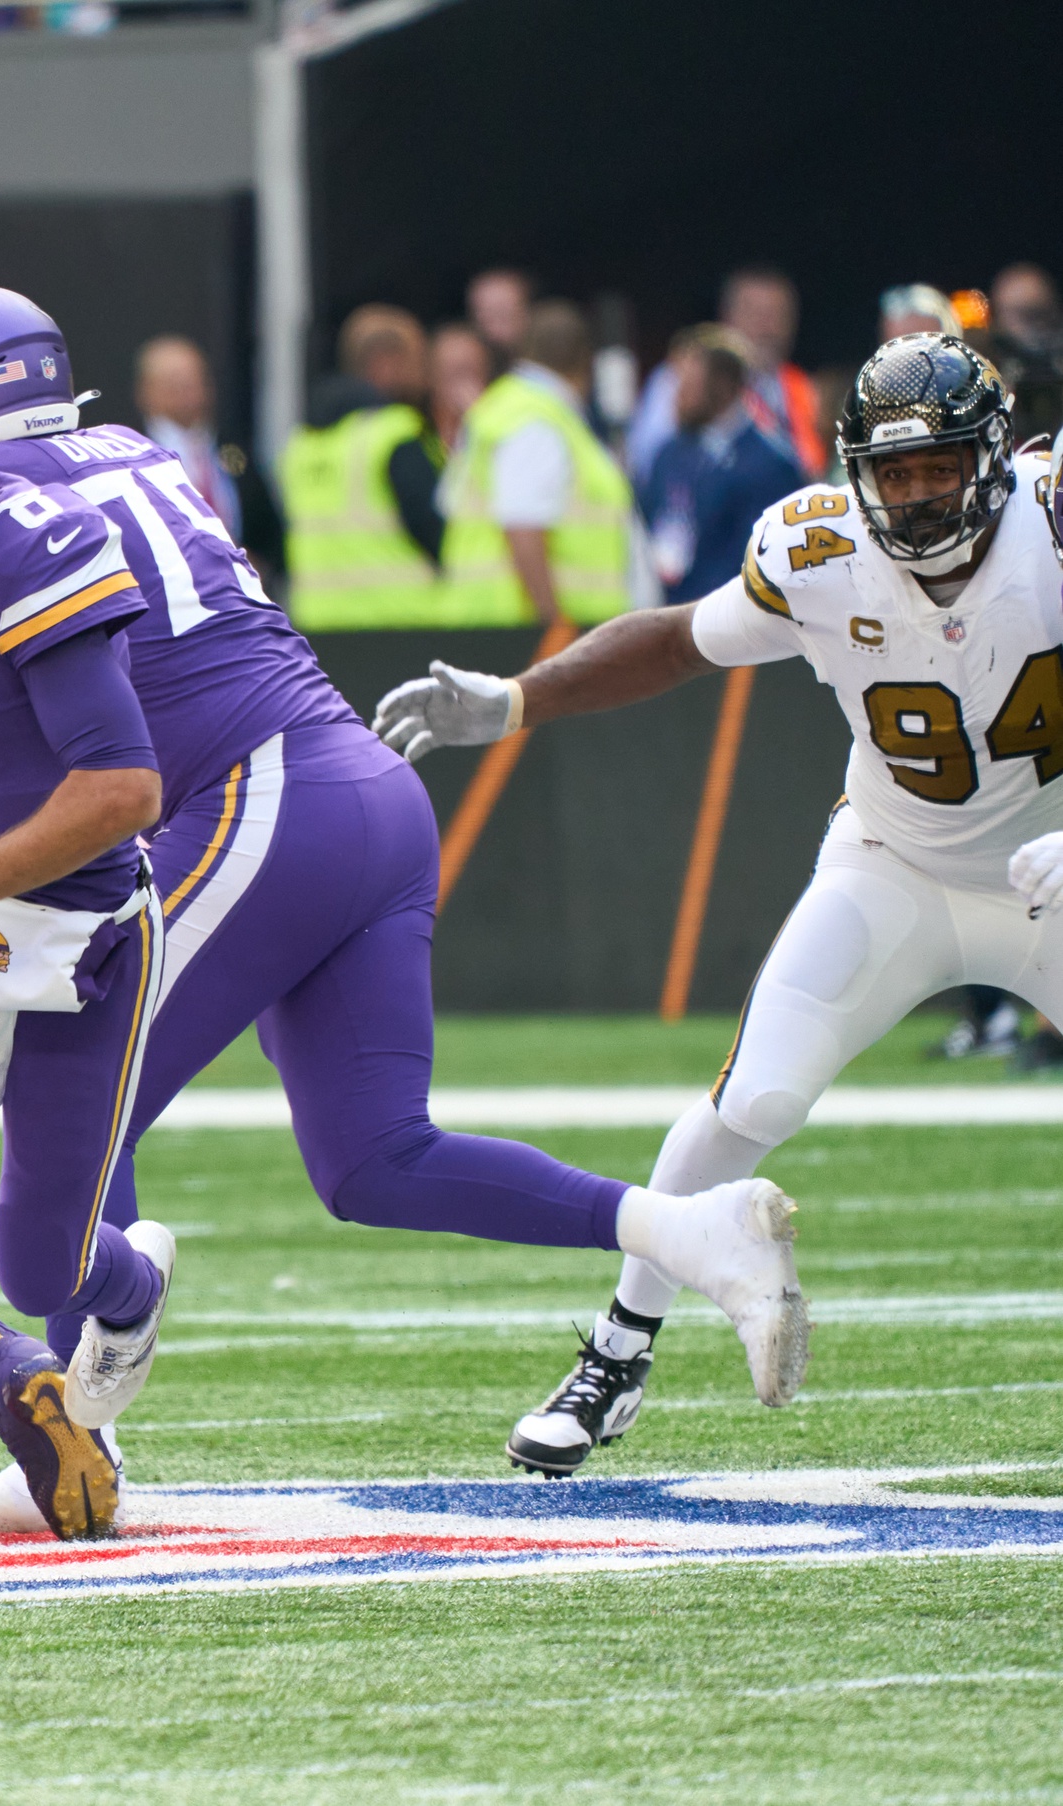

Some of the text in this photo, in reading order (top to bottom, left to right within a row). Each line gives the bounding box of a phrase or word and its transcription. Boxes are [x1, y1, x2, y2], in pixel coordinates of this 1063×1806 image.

[882, 426, 913, 438] SAINTS
[782, 493, 856, 572] 94
[849, 616, 884, 647] C
[862, 645, 1063, 806] 94
